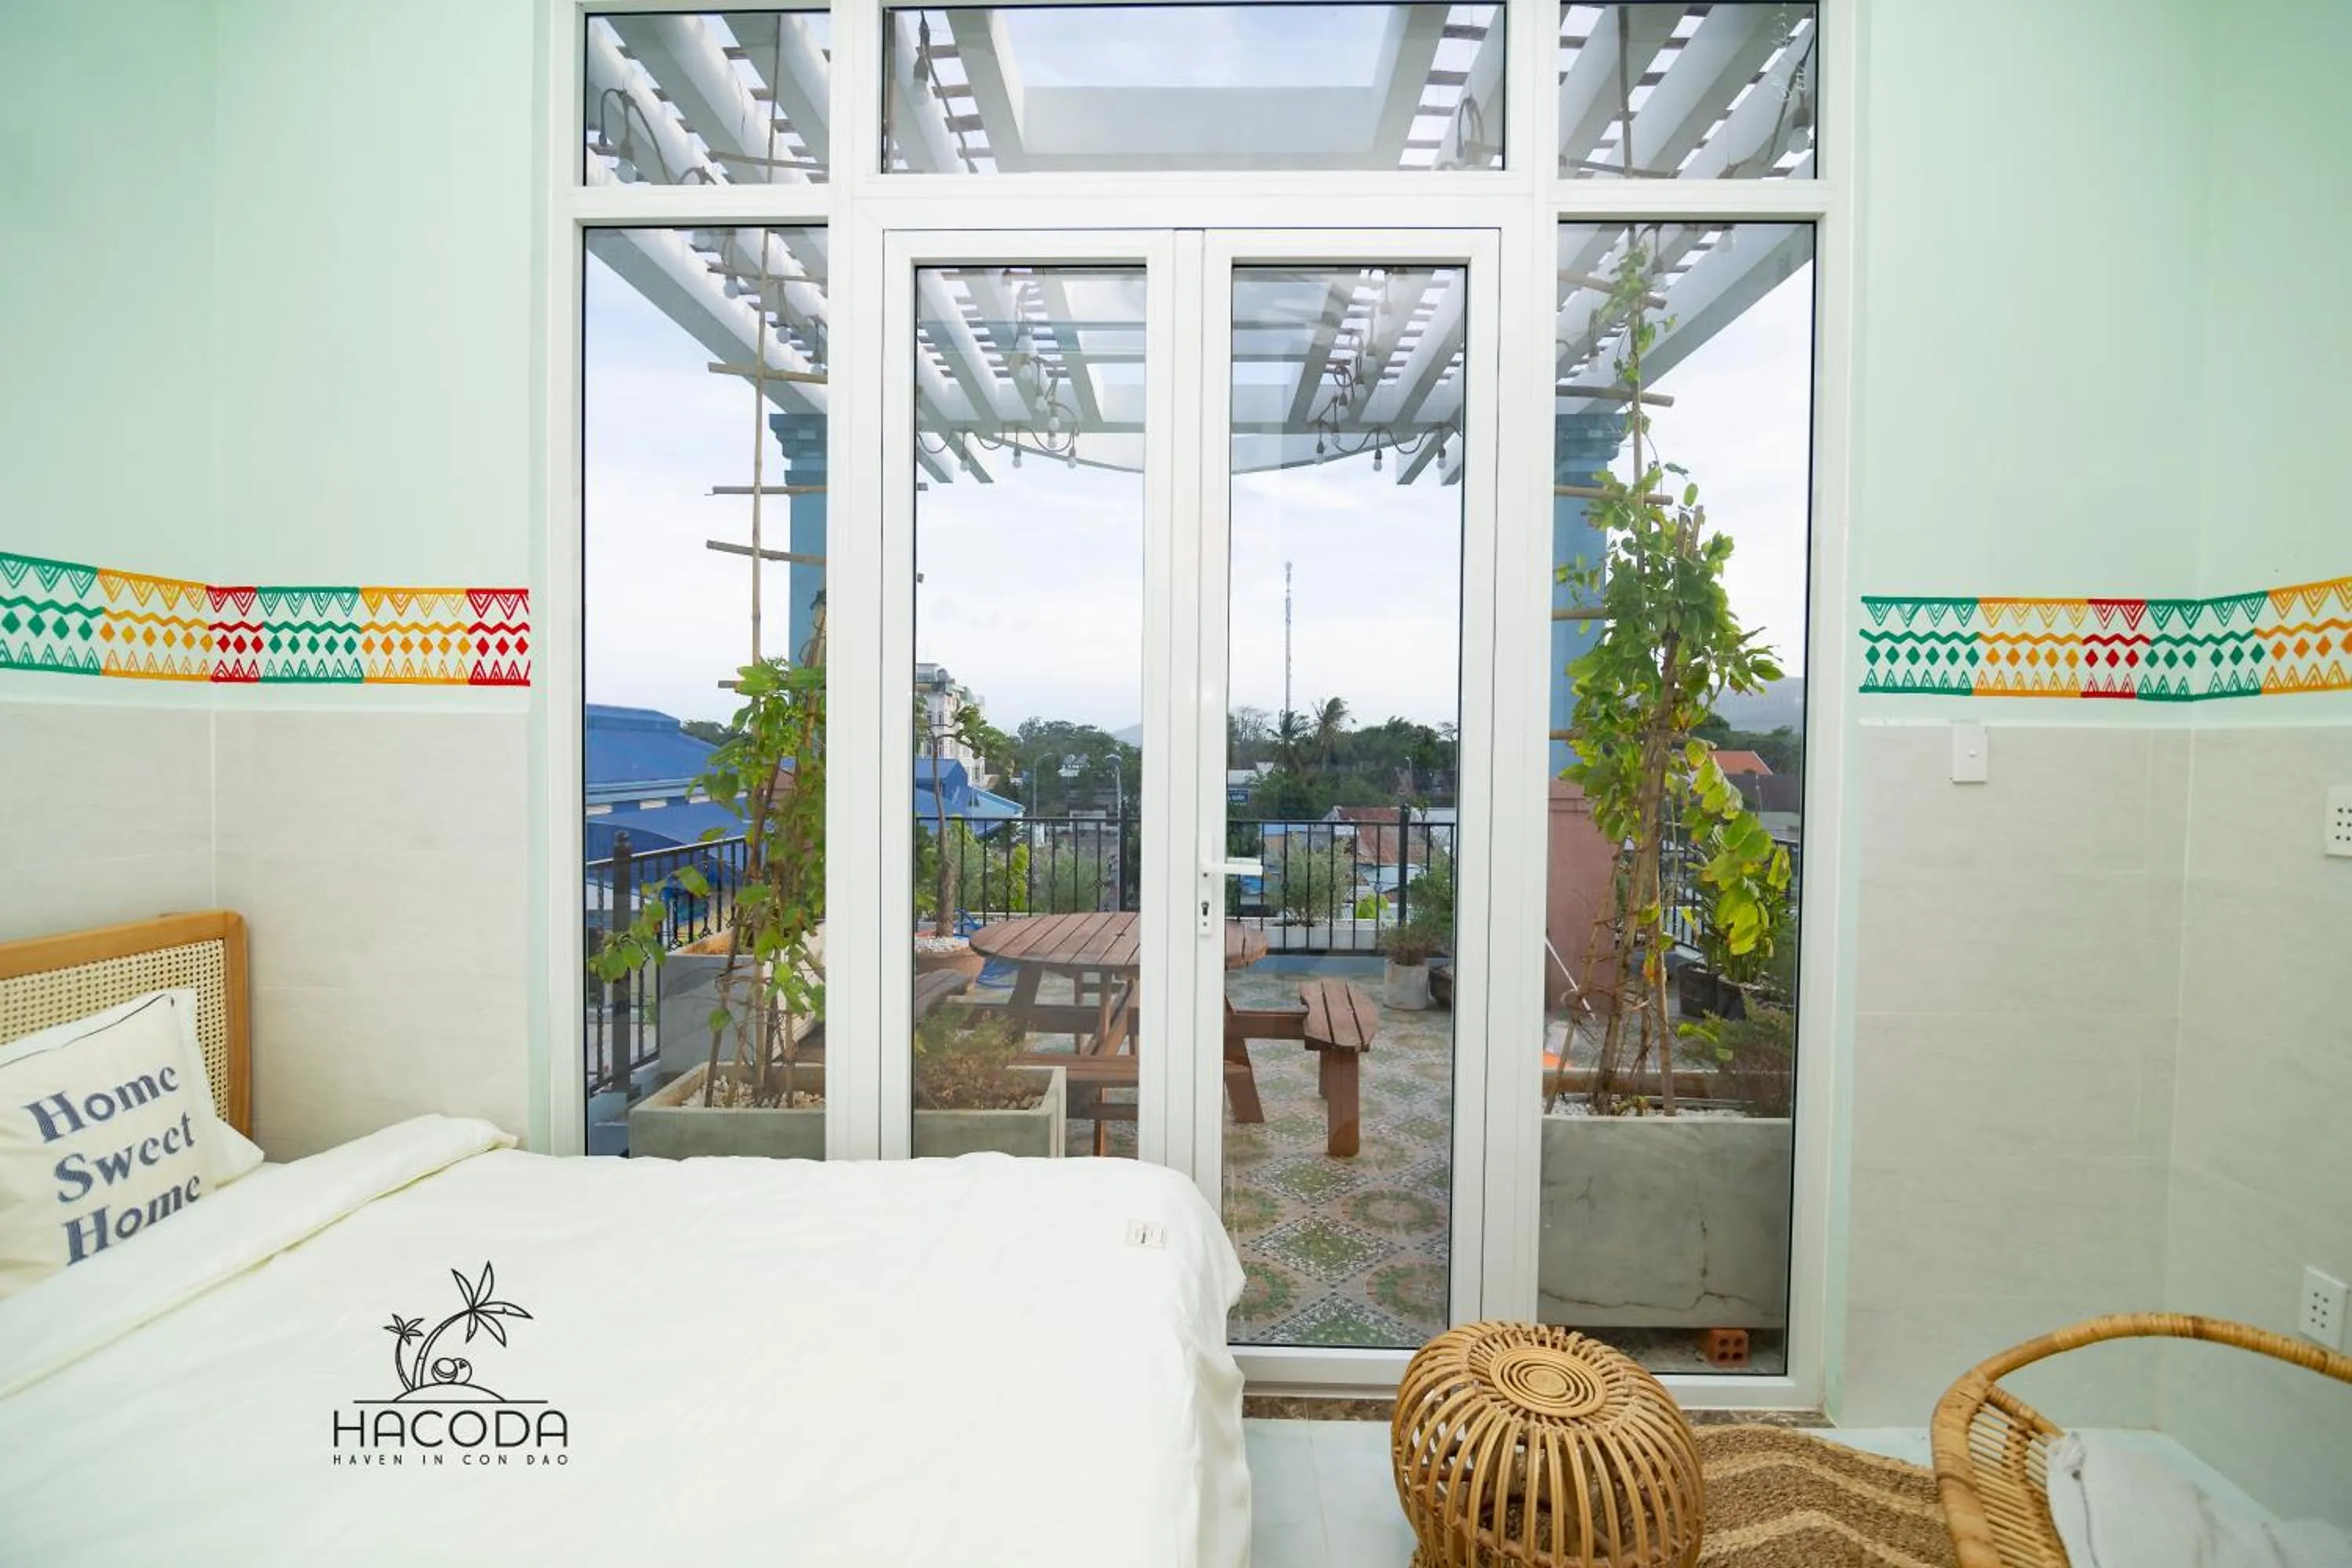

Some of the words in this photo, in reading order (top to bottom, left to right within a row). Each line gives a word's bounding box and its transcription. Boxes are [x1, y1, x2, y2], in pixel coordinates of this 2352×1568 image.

[21, 1065, 180, 1143] Home
[54, 1111, 195, 1203] Sweet
[60, 1174, 201, 1266] Home
